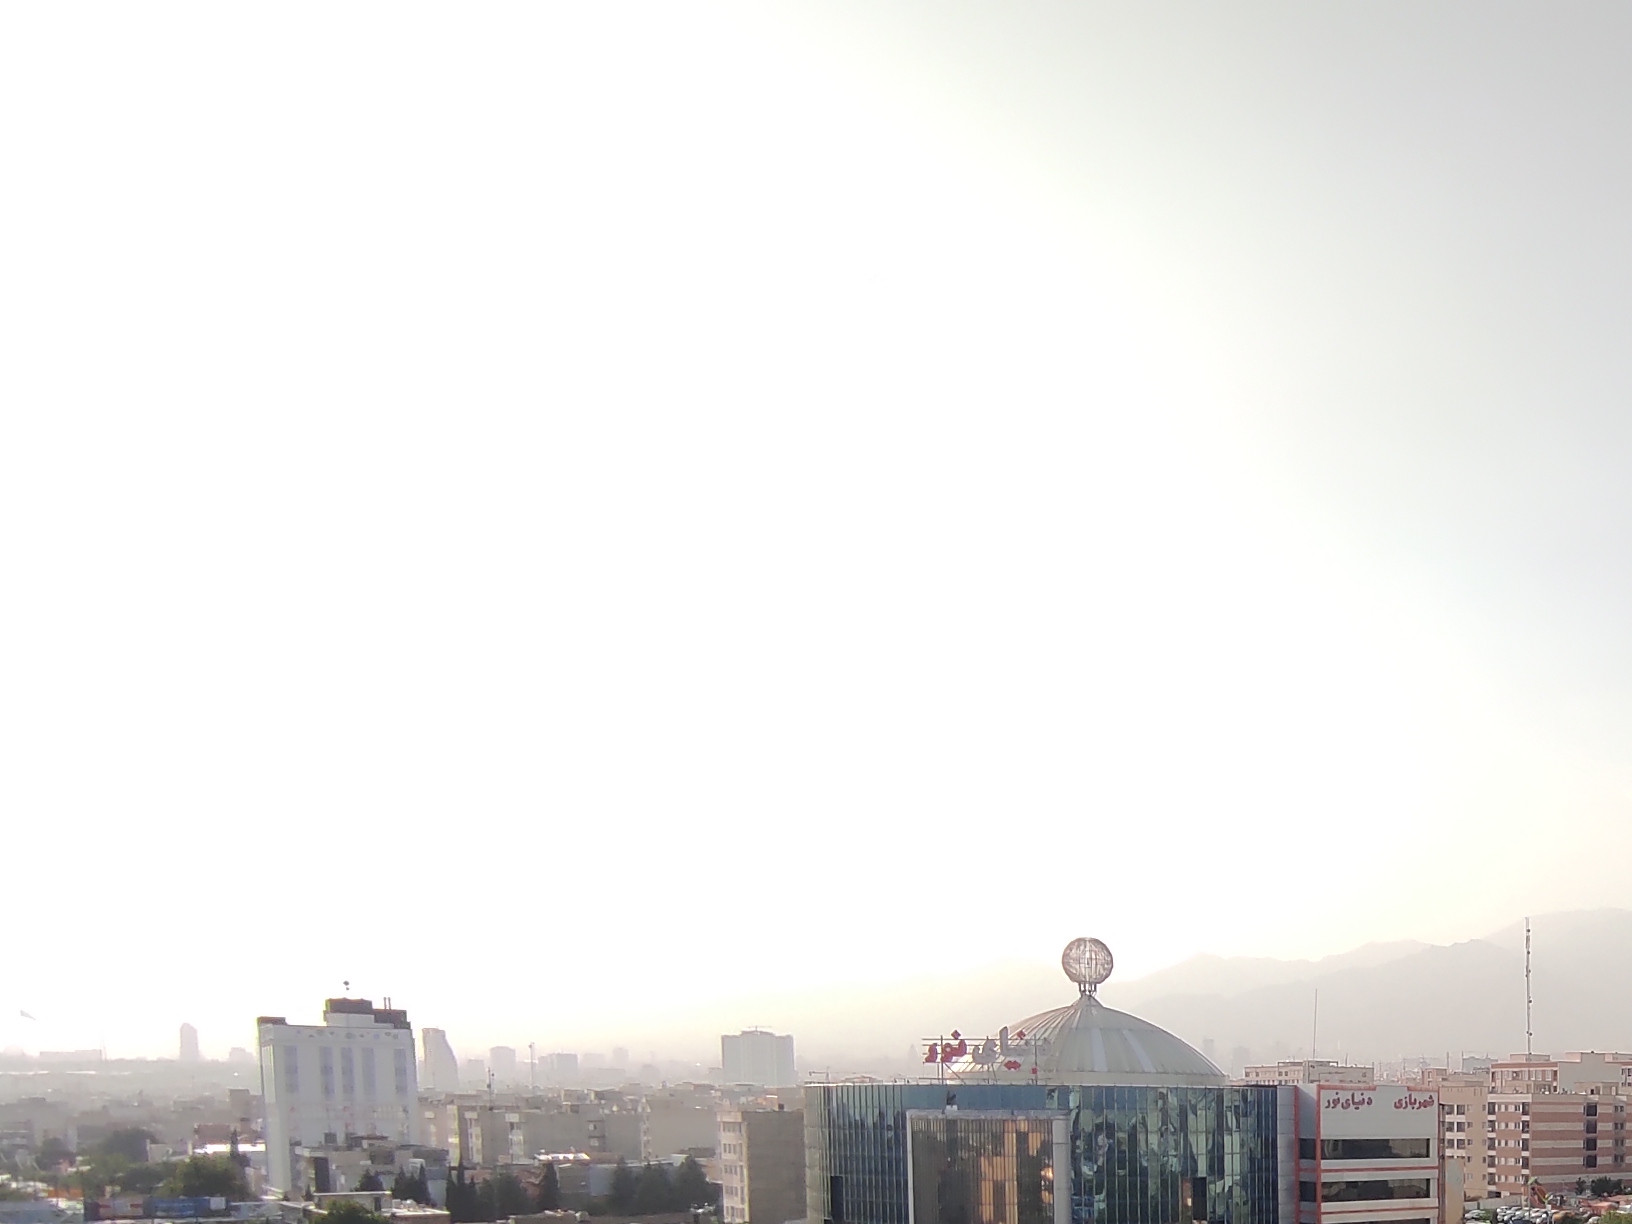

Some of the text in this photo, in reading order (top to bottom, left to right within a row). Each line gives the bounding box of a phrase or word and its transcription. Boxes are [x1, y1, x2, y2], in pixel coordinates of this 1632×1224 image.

[924, 1029, 968, 1064] نور
[1324, 1091, 1435, 1110] شهربازی دنیای نور
